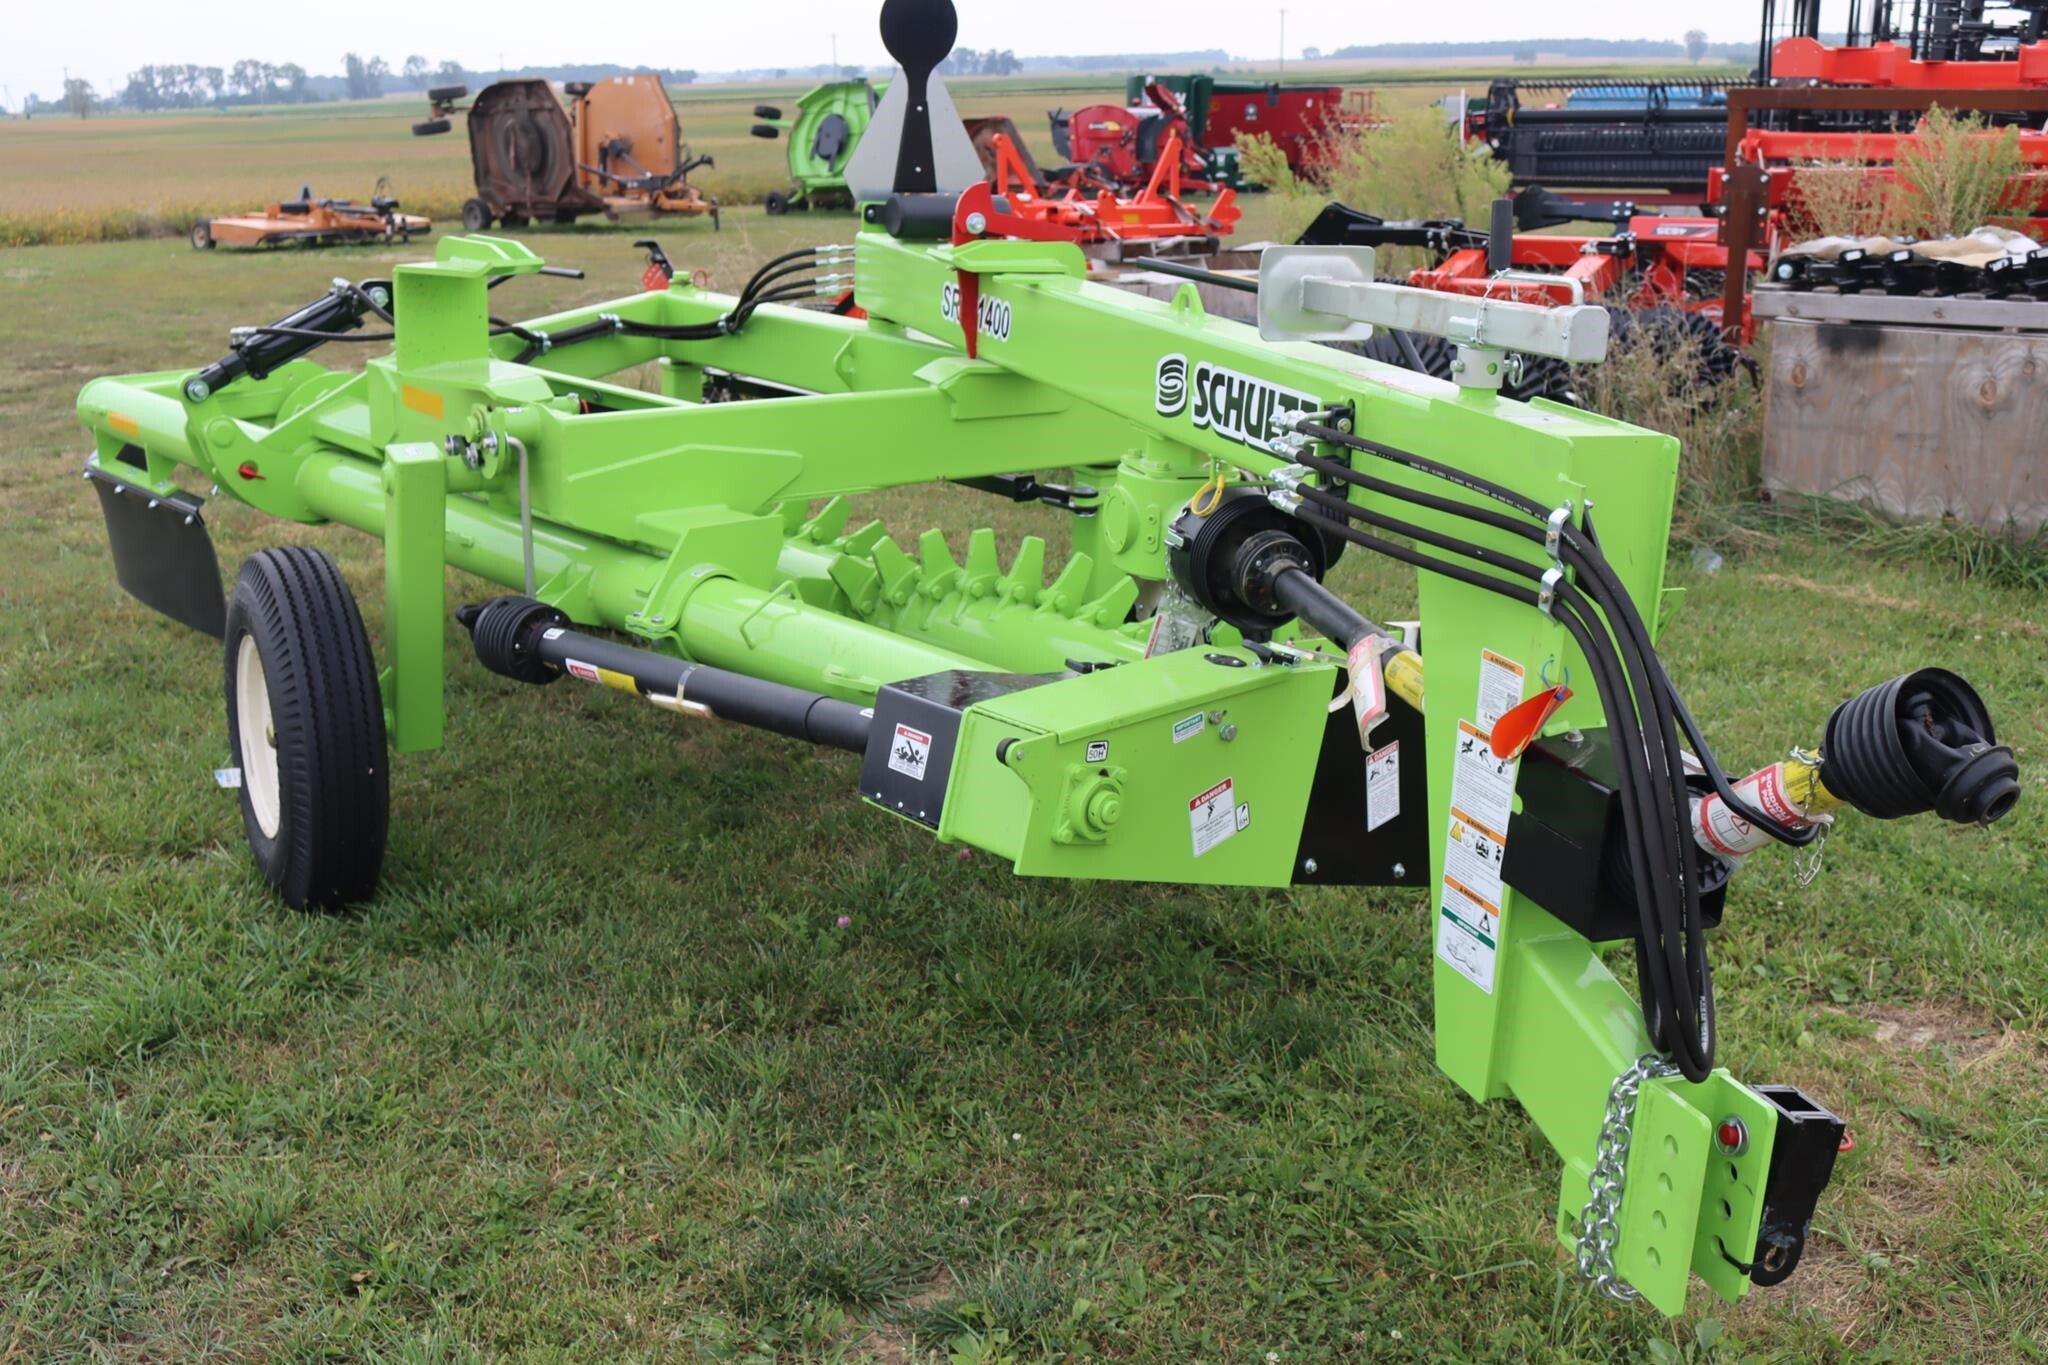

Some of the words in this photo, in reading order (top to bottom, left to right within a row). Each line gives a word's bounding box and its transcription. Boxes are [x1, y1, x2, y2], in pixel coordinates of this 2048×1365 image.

[979, 297, 1010, 338] 1400
[1194, 367, 1319, 444] SCHULT
[1201, 783, 1227, 803] DANGER
